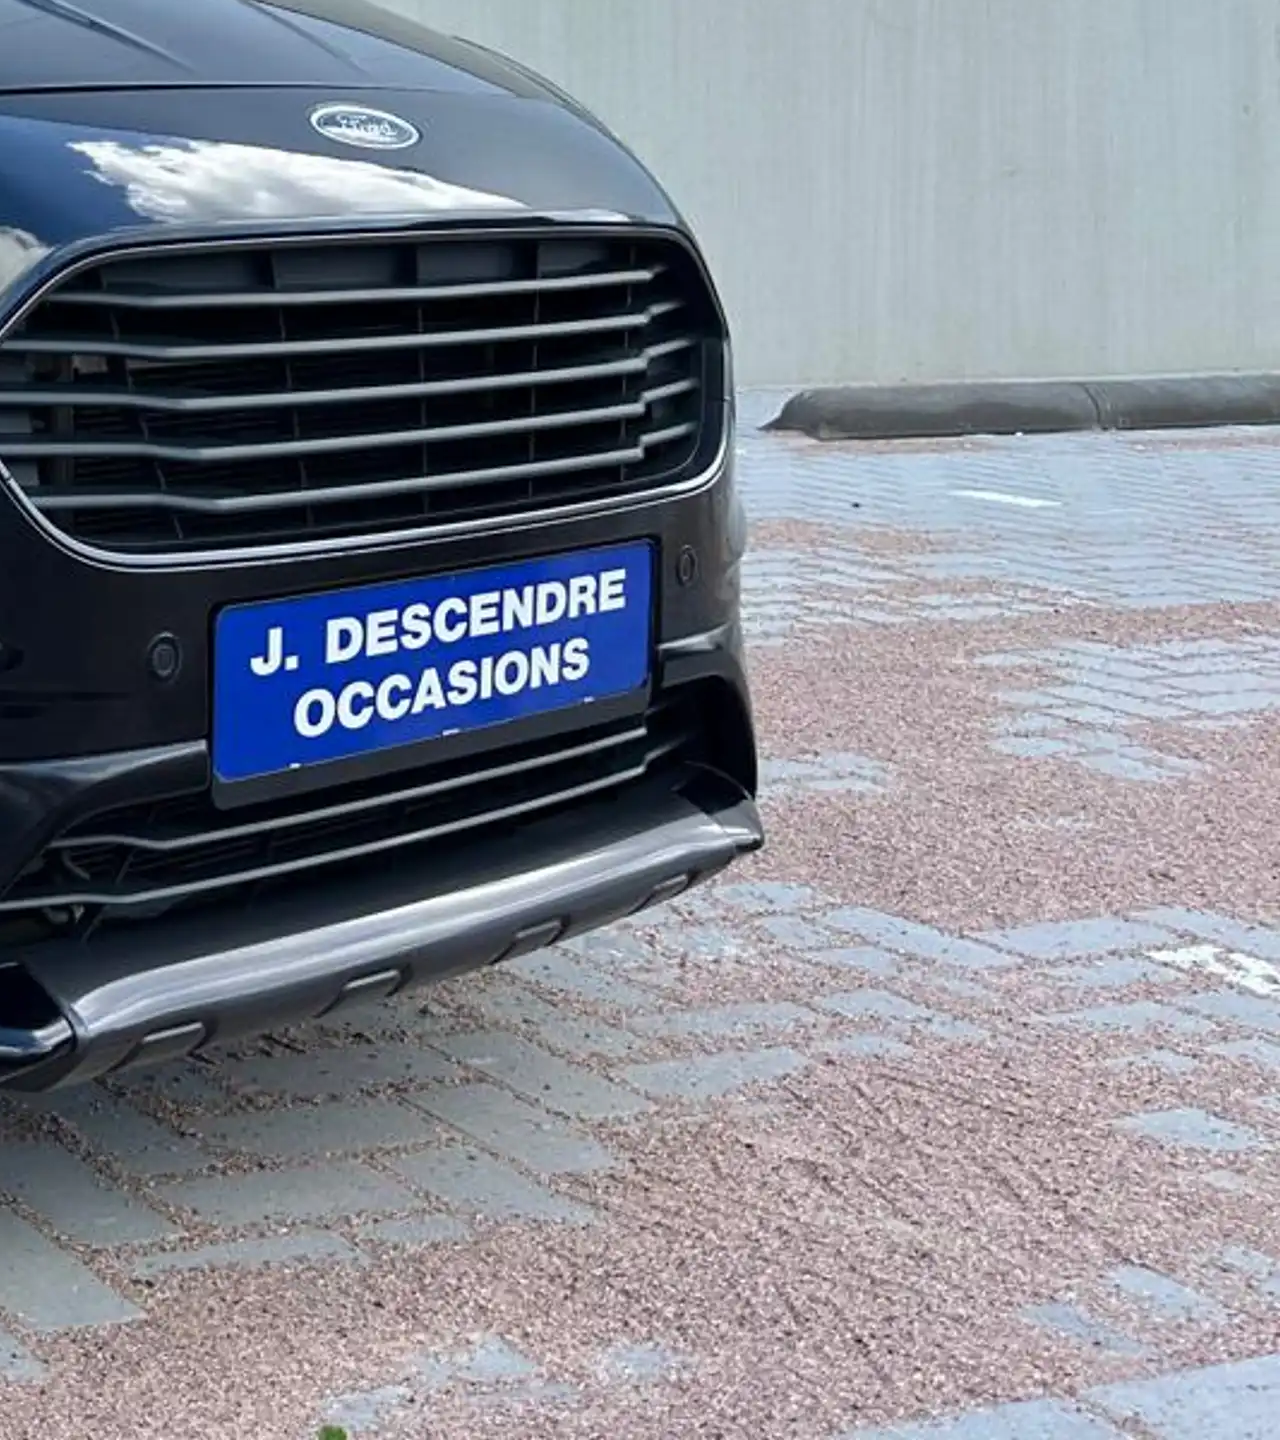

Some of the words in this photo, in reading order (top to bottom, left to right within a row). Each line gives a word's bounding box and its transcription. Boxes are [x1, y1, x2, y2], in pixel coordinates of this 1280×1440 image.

[250, 626, 299, 676] J.
[325, 568, 627, 665] DESCENDRE
[293, 637, 590, 738] OCCASIONS
